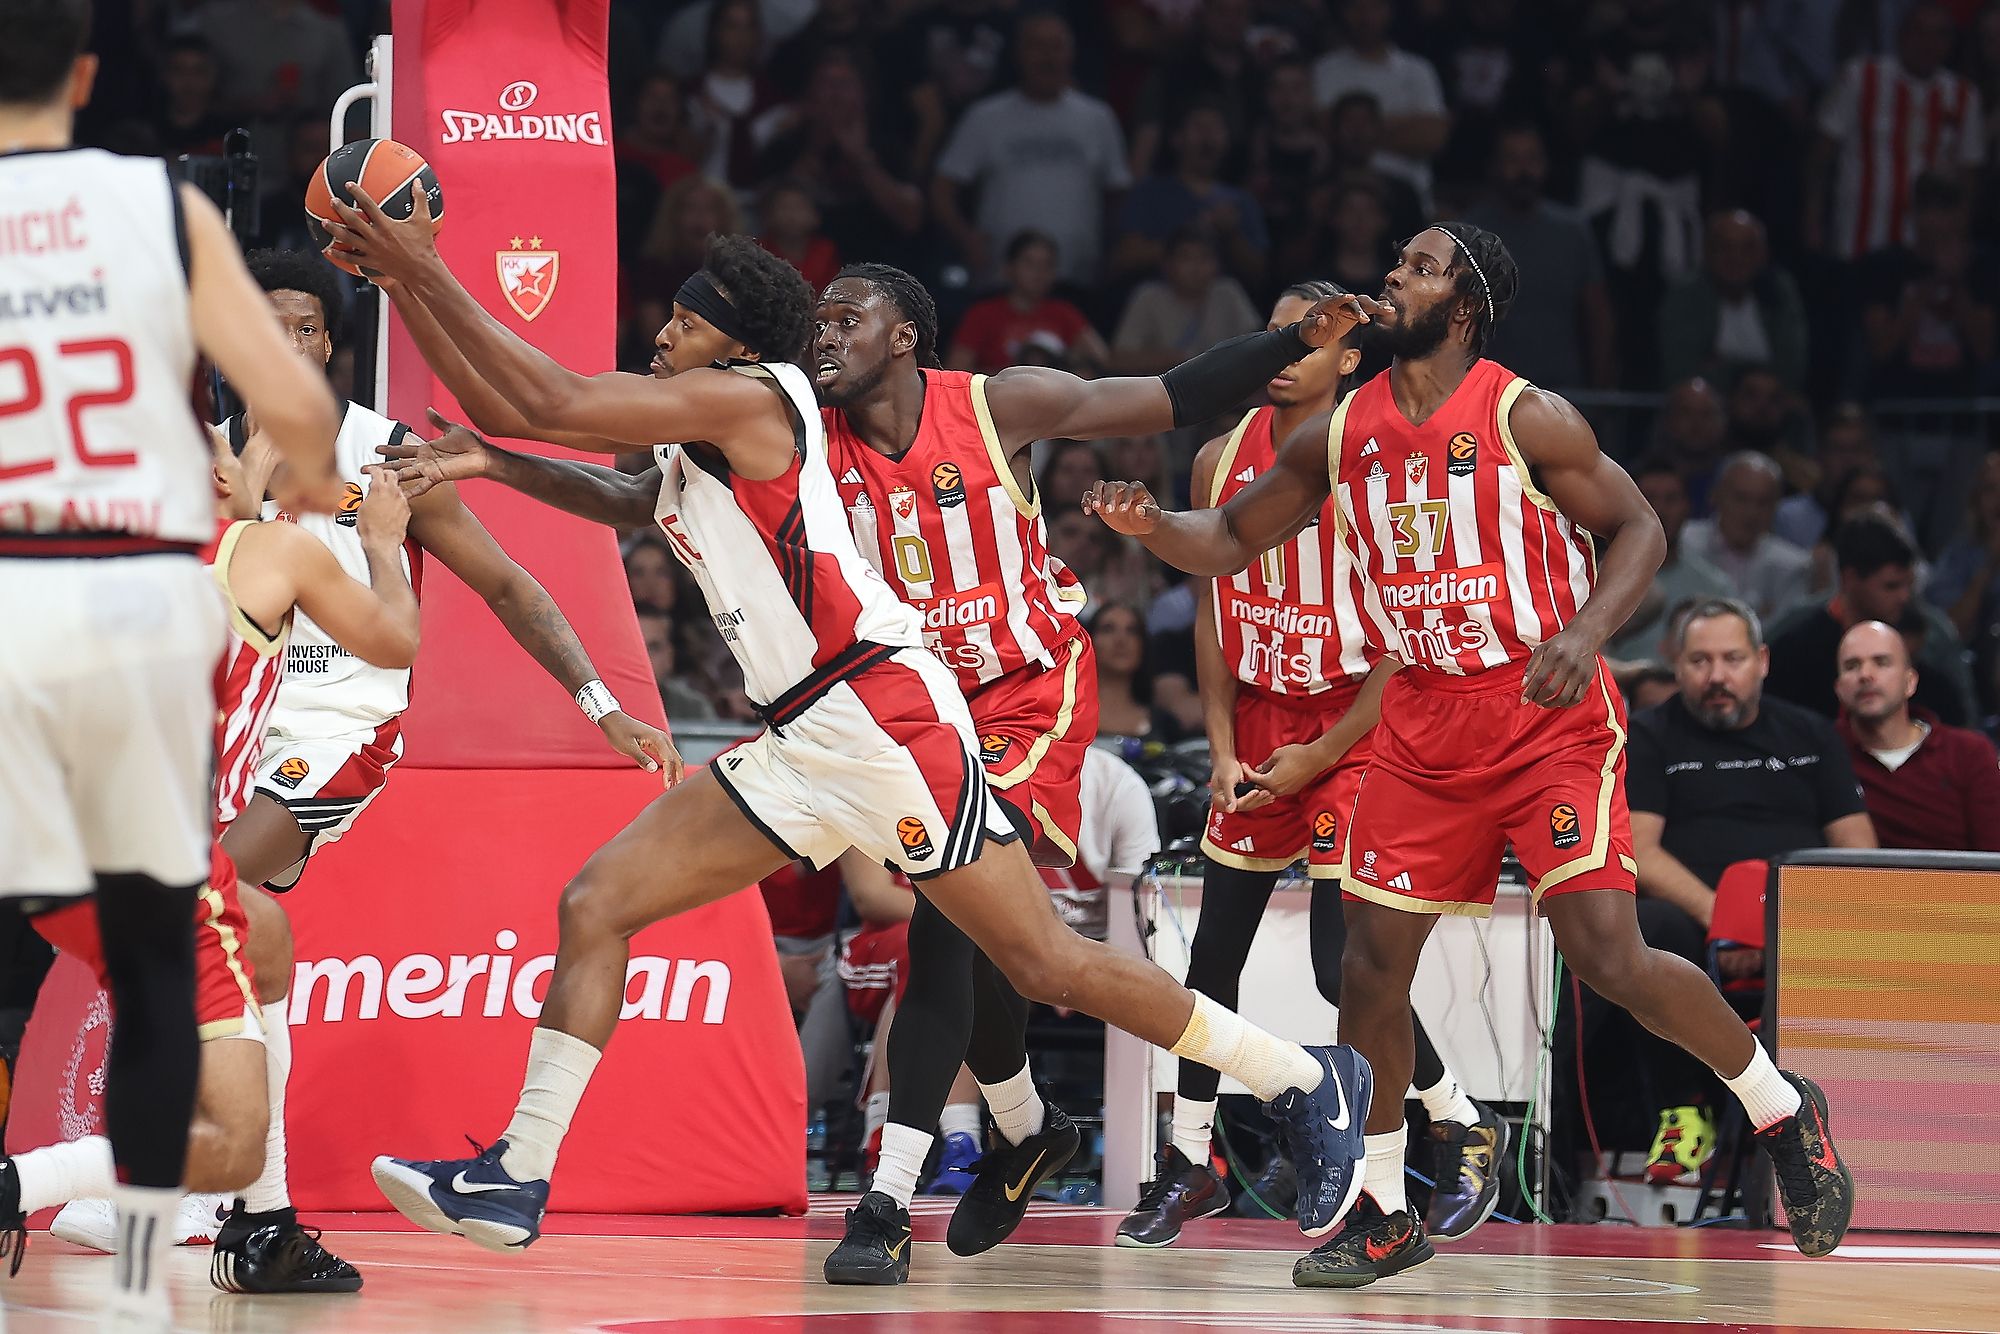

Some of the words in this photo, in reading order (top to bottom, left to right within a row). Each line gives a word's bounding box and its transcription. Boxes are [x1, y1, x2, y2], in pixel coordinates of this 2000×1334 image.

[441, 109, 606, 146] SPALDING
[0, 196, 86, 255] ICIĆ
[0, 339, 137, 481] 22
[1387, 498, 1449, 558] 37
[891, 533, 934, 584] 0
[918, 594, 996, 629] idian
[1382, 572, 1498, 609] meridian
[1231, 598, 1333, 637] meridian
[287, 644, 354, 659] INVESTME
[932, 638, 985, 669] ts
[1401, 617, 1488, 662] mts
[287, 660, 329, 673] HOUSE
[1250, 639, 1312, 685] mts
[289, 929, 731, 1025] merian
